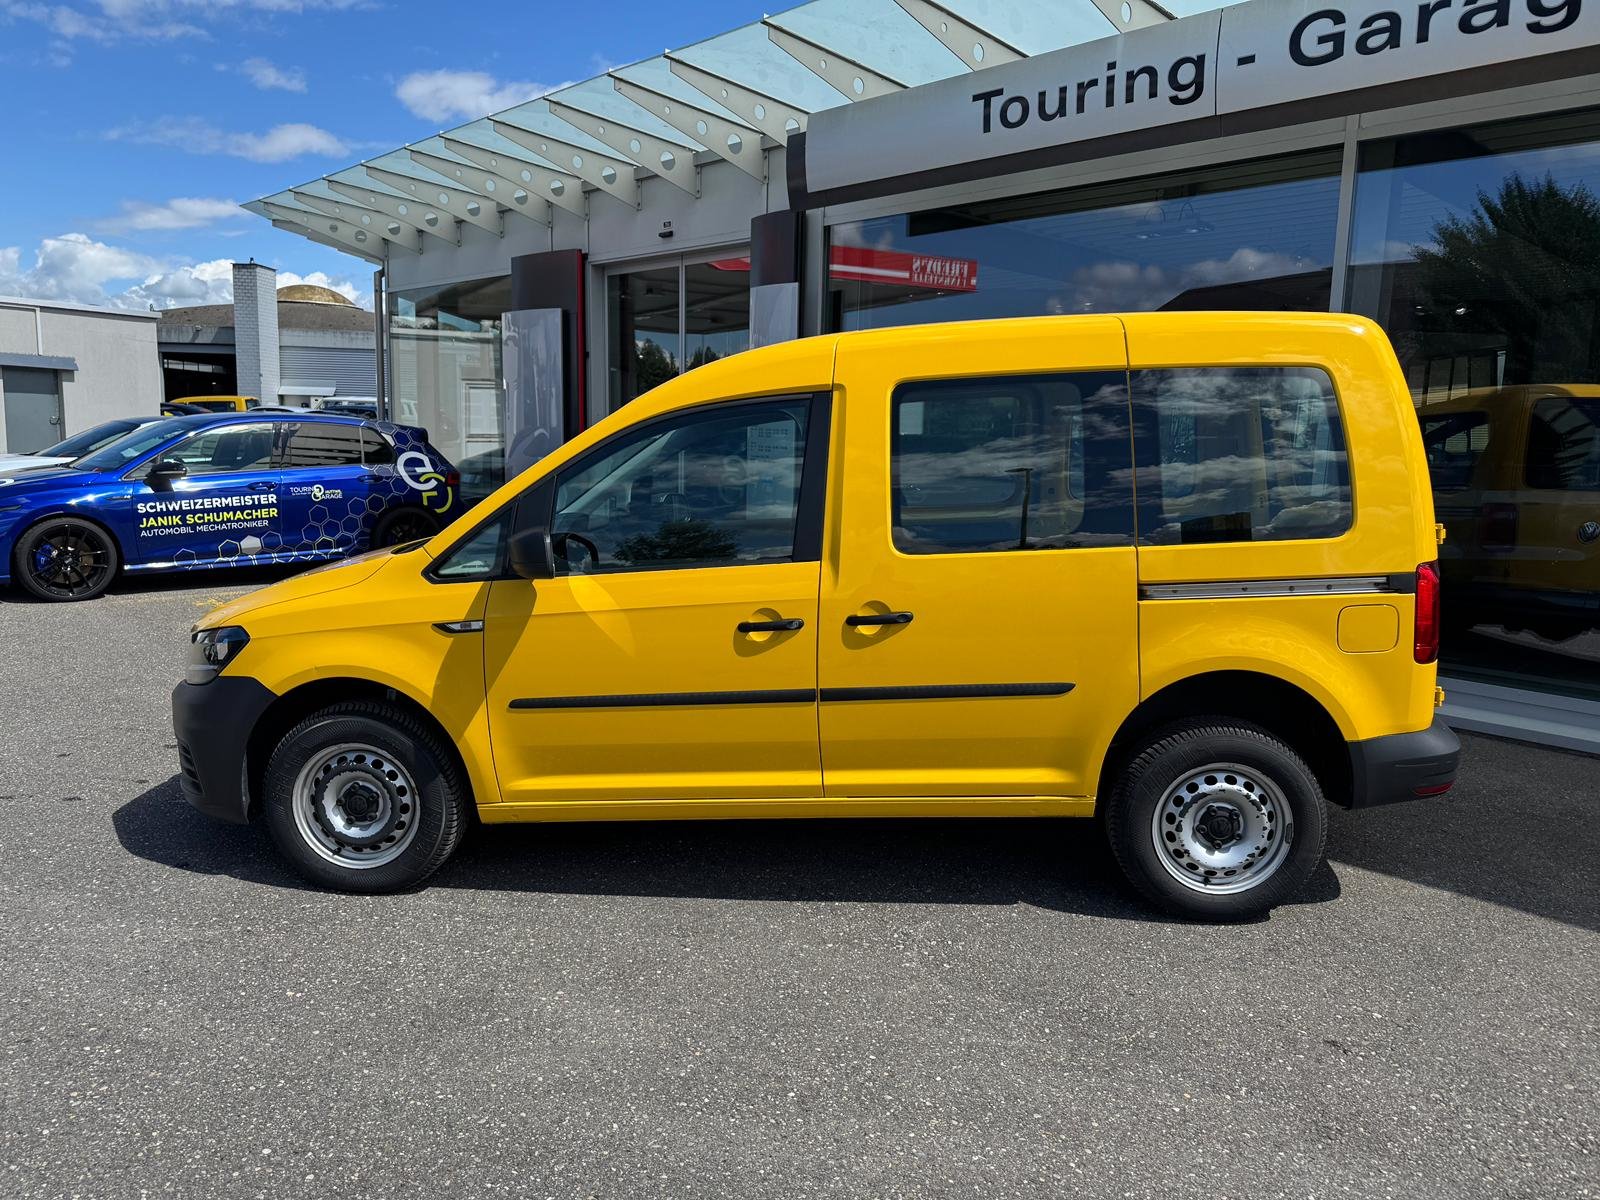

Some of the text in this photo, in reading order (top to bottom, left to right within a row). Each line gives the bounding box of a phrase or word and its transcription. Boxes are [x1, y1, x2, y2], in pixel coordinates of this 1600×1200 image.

[972, 53, 1206, 134] Touring
[137, 493, 277, 513] SCHWEIZERMEISTER
[140, 508, 278, 528] JANIK SCHUMACHER
[140, 519, 269, 537] AUTOMOBIL MECHATRONIKER
